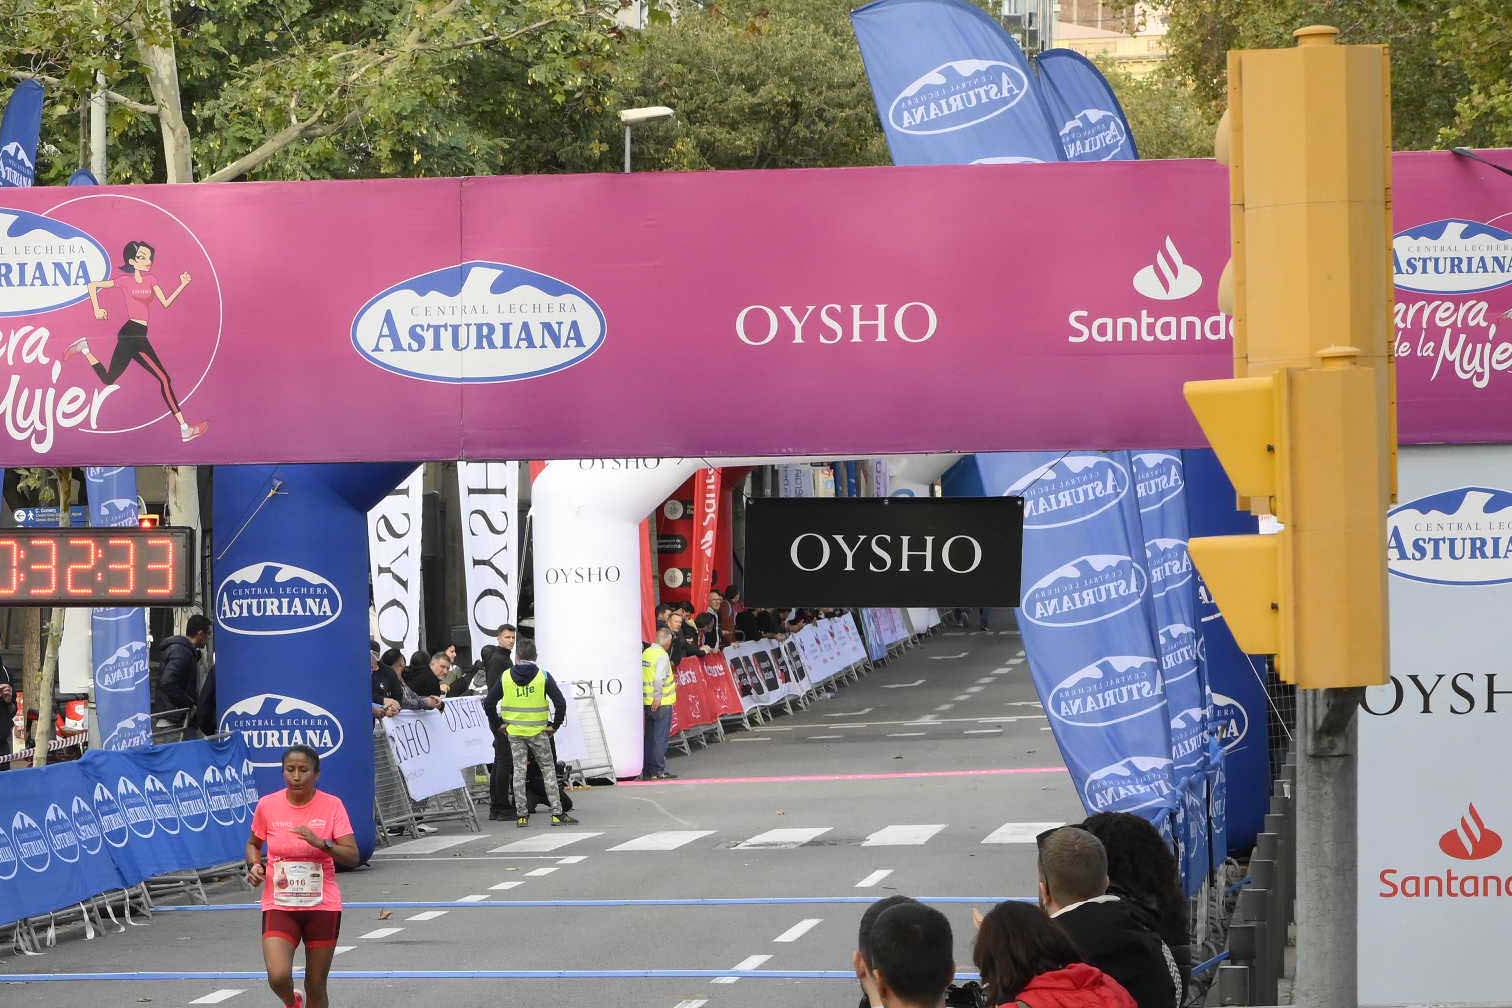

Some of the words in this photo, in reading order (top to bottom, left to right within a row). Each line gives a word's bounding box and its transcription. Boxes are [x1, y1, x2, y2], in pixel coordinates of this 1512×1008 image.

[13, 244, 86, 255] LECHERA
[1464, 243, 1512, 252] LECHER
[410, 304, 490, 317] CENTRAL
[496, 302, 578, 314] LECHERA
[1394, 300, 1489, 330] arrera
[371, 308, 587, 353] ASTURIANA
[735, 301, 938, 346] OYSHO
[1068, 310, 1235, 343] Santand
[1417, 331, 1435, 357] la
[1431, 323, 1512, 389] Muje
[1414, 522, 1482, 531] CENTRAL
[789, 533, 982, 574] OYSHO
[545, 566, 621, 585] OYSHO
[233, 587, 275, 596] CENTRAL
[279, 587, 328, 595] LECHERA
[220, 592, 332, 619] ASTURIANA
[516, 686, 535, 698] Life
[280, 718, 329, 726] LECHERA
